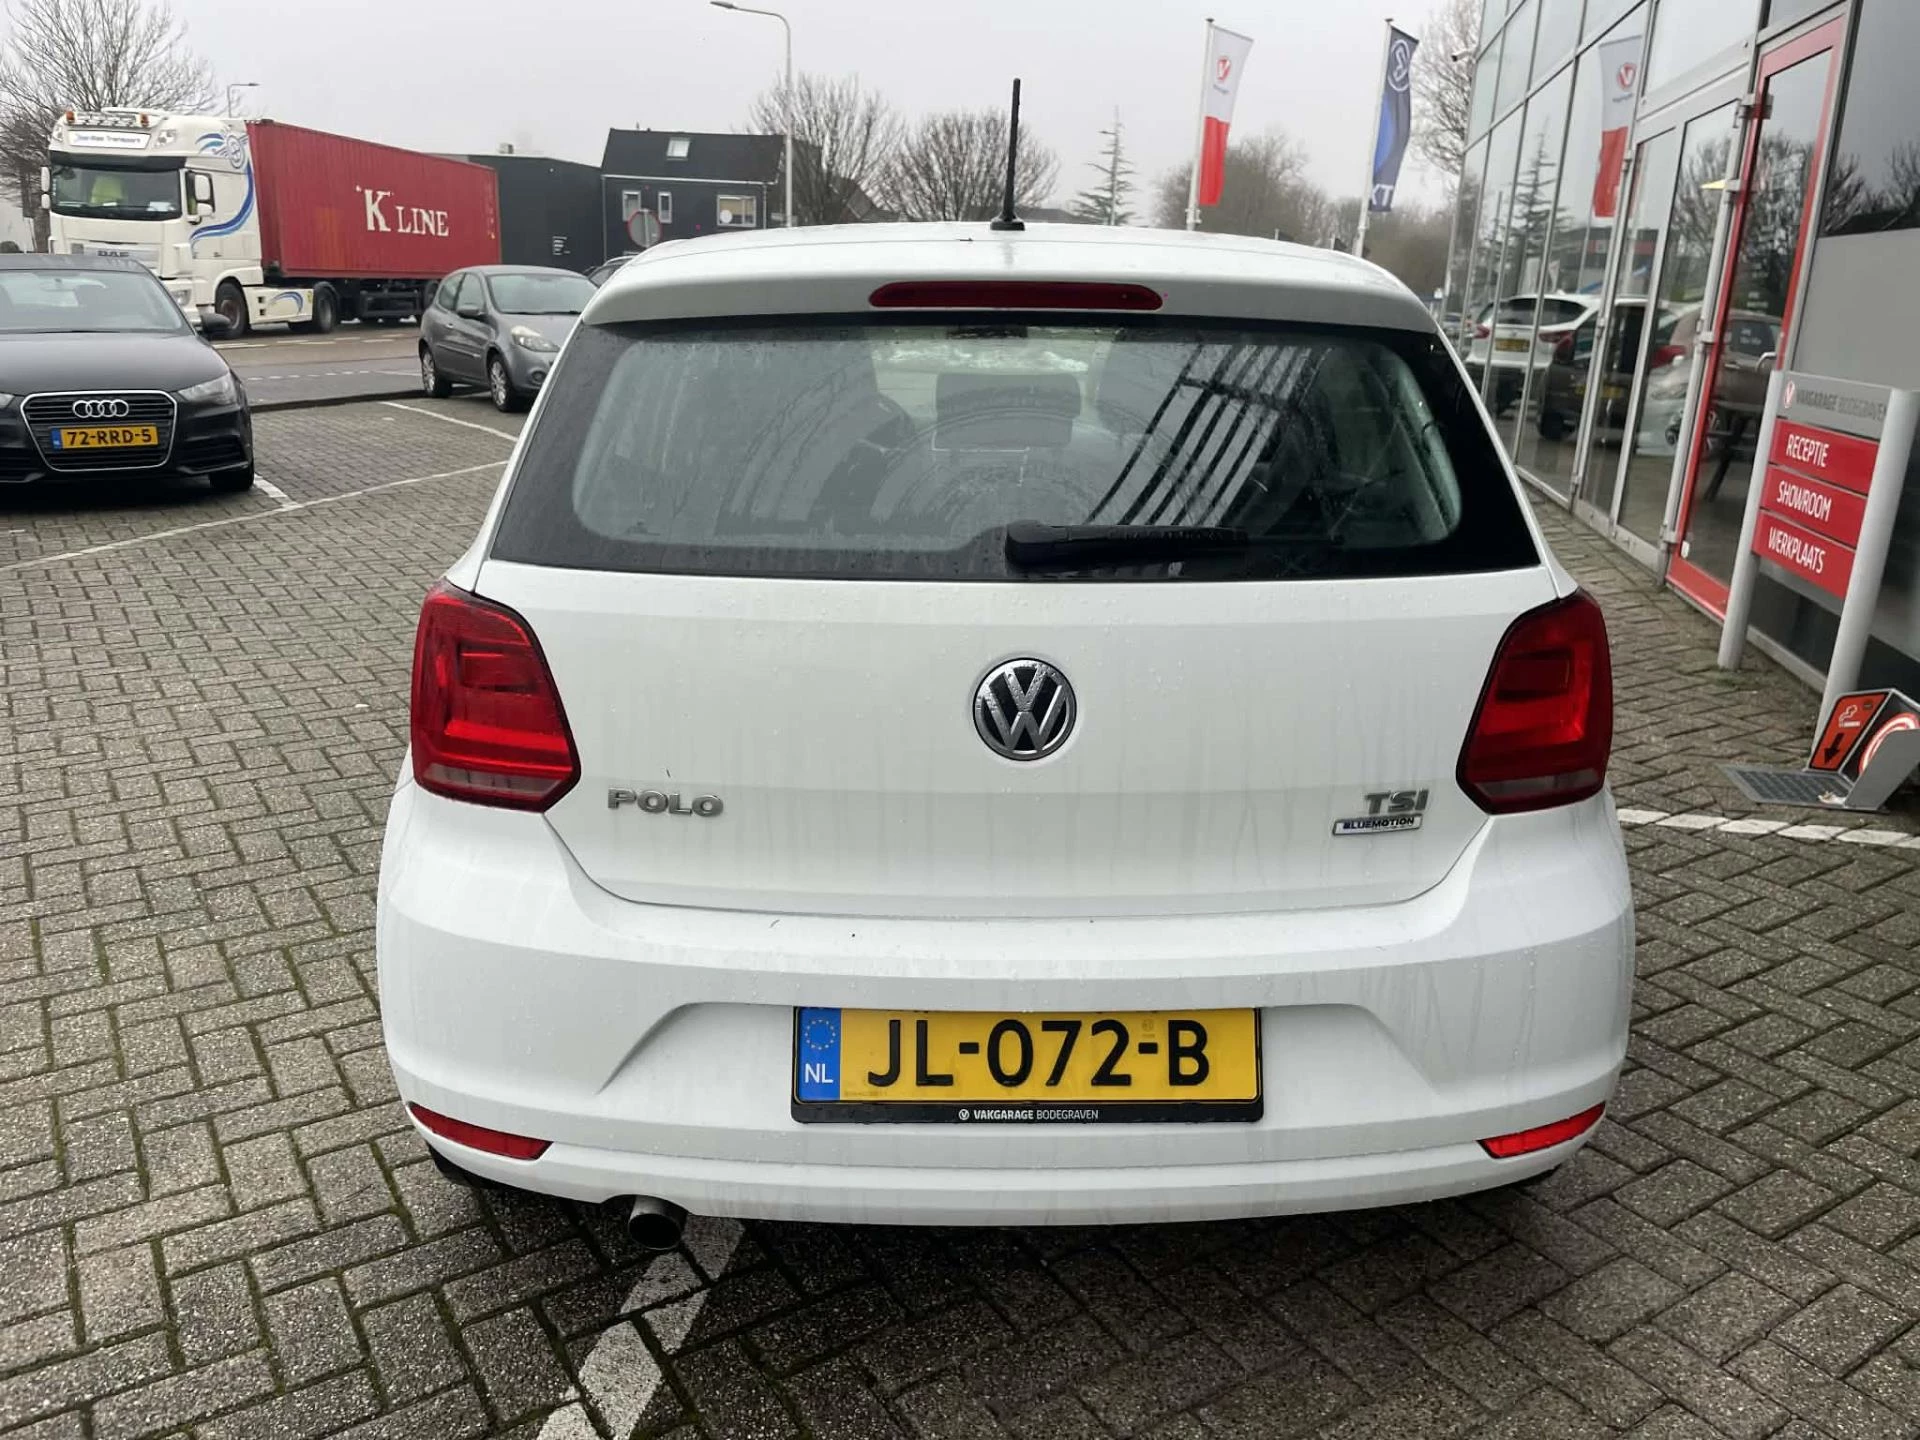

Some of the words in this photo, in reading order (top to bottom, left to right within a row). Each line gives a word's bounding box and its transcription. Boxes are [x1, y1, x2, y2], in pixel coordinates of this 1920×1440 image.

[395, 206, 449, 237] LINE
[67, 428, 152, 445] 72-RRD-5
[1786, 434, 1829, 467] RECEPTIE
[1777, 480, 1831, 522] SHOWROOM
[1768, 527, 1826, 573] WERKPLAATS
[607, 787, 723, 817] POLO
[1365, 789, 1429, 814] TSI
[1342, 817, 1415, 829] BLUEMOTION
[868, 1019, 1210, 1087] JL-072-B
[804, 1063, 834, 1083] NL
[973, 1109, 1034, 1120] VAKGARAGE
[1036, 1109, 1099, 1120] BODEGRAVEN
